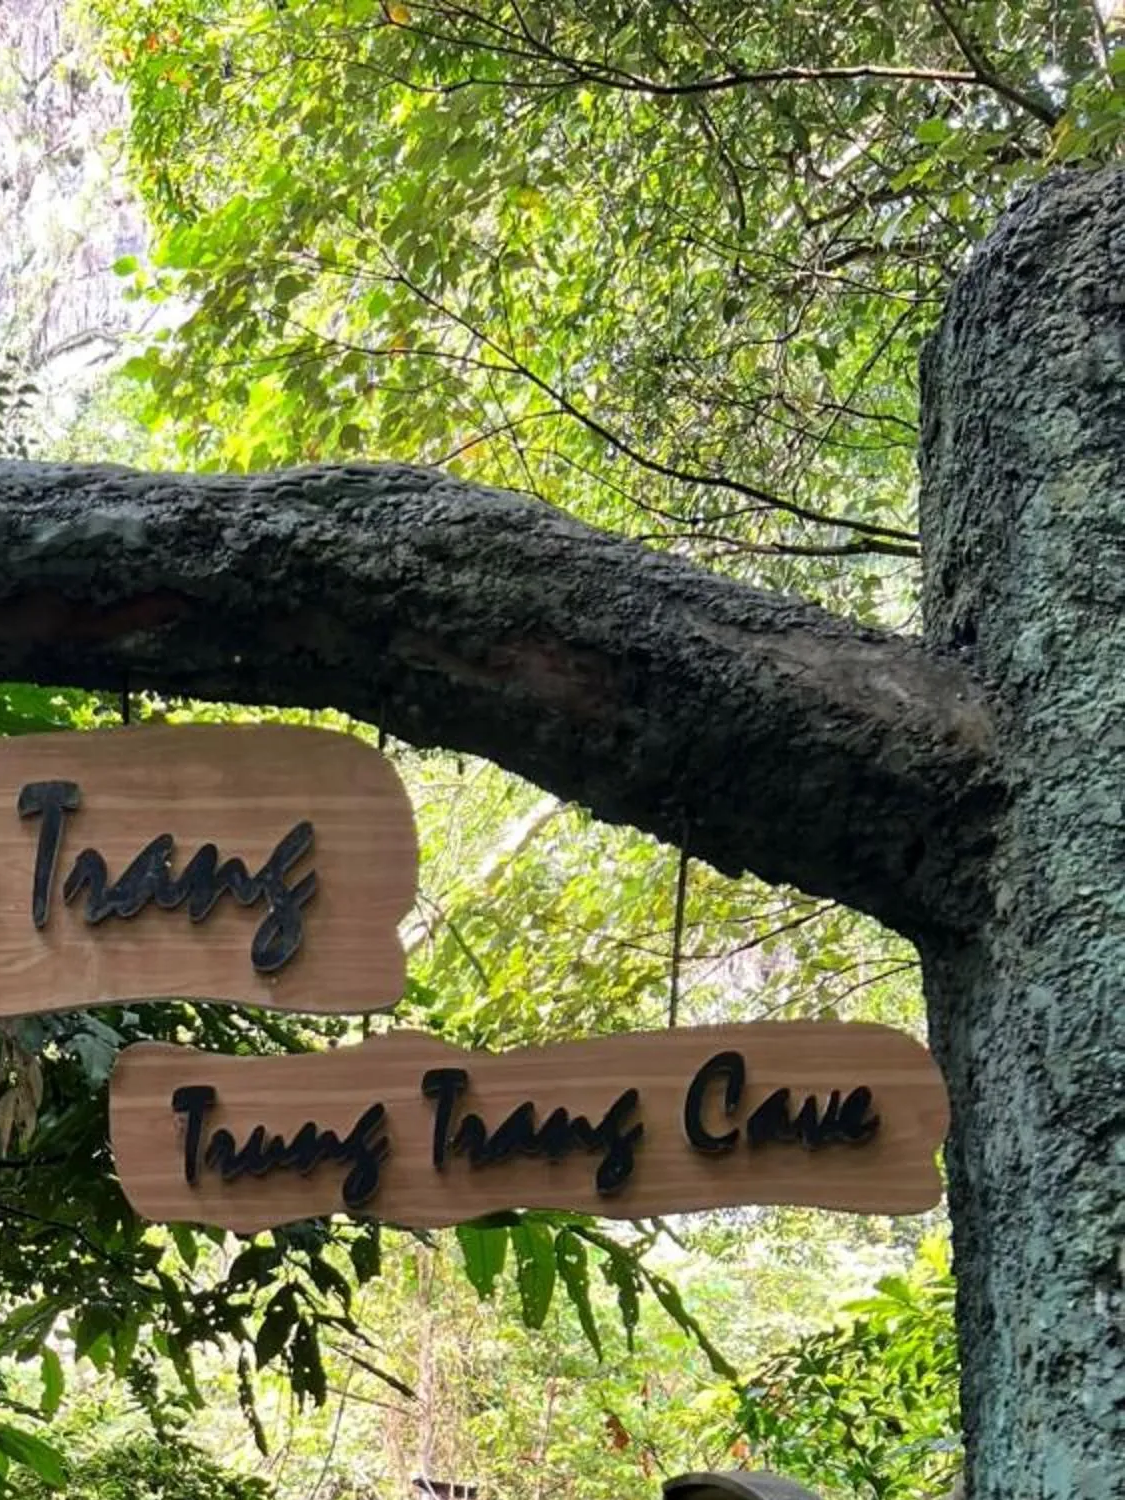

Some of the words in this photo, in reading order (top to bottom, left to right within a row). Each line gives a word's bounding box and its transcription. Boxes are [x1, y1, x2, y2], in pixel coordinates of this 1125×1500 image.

[17, 780, 316, 973] Trang
[171, 1085, 390, 1209] Trung
[421, 1067, 644, 1197] Trang
[683, 1050, 880, 1154] Cave
